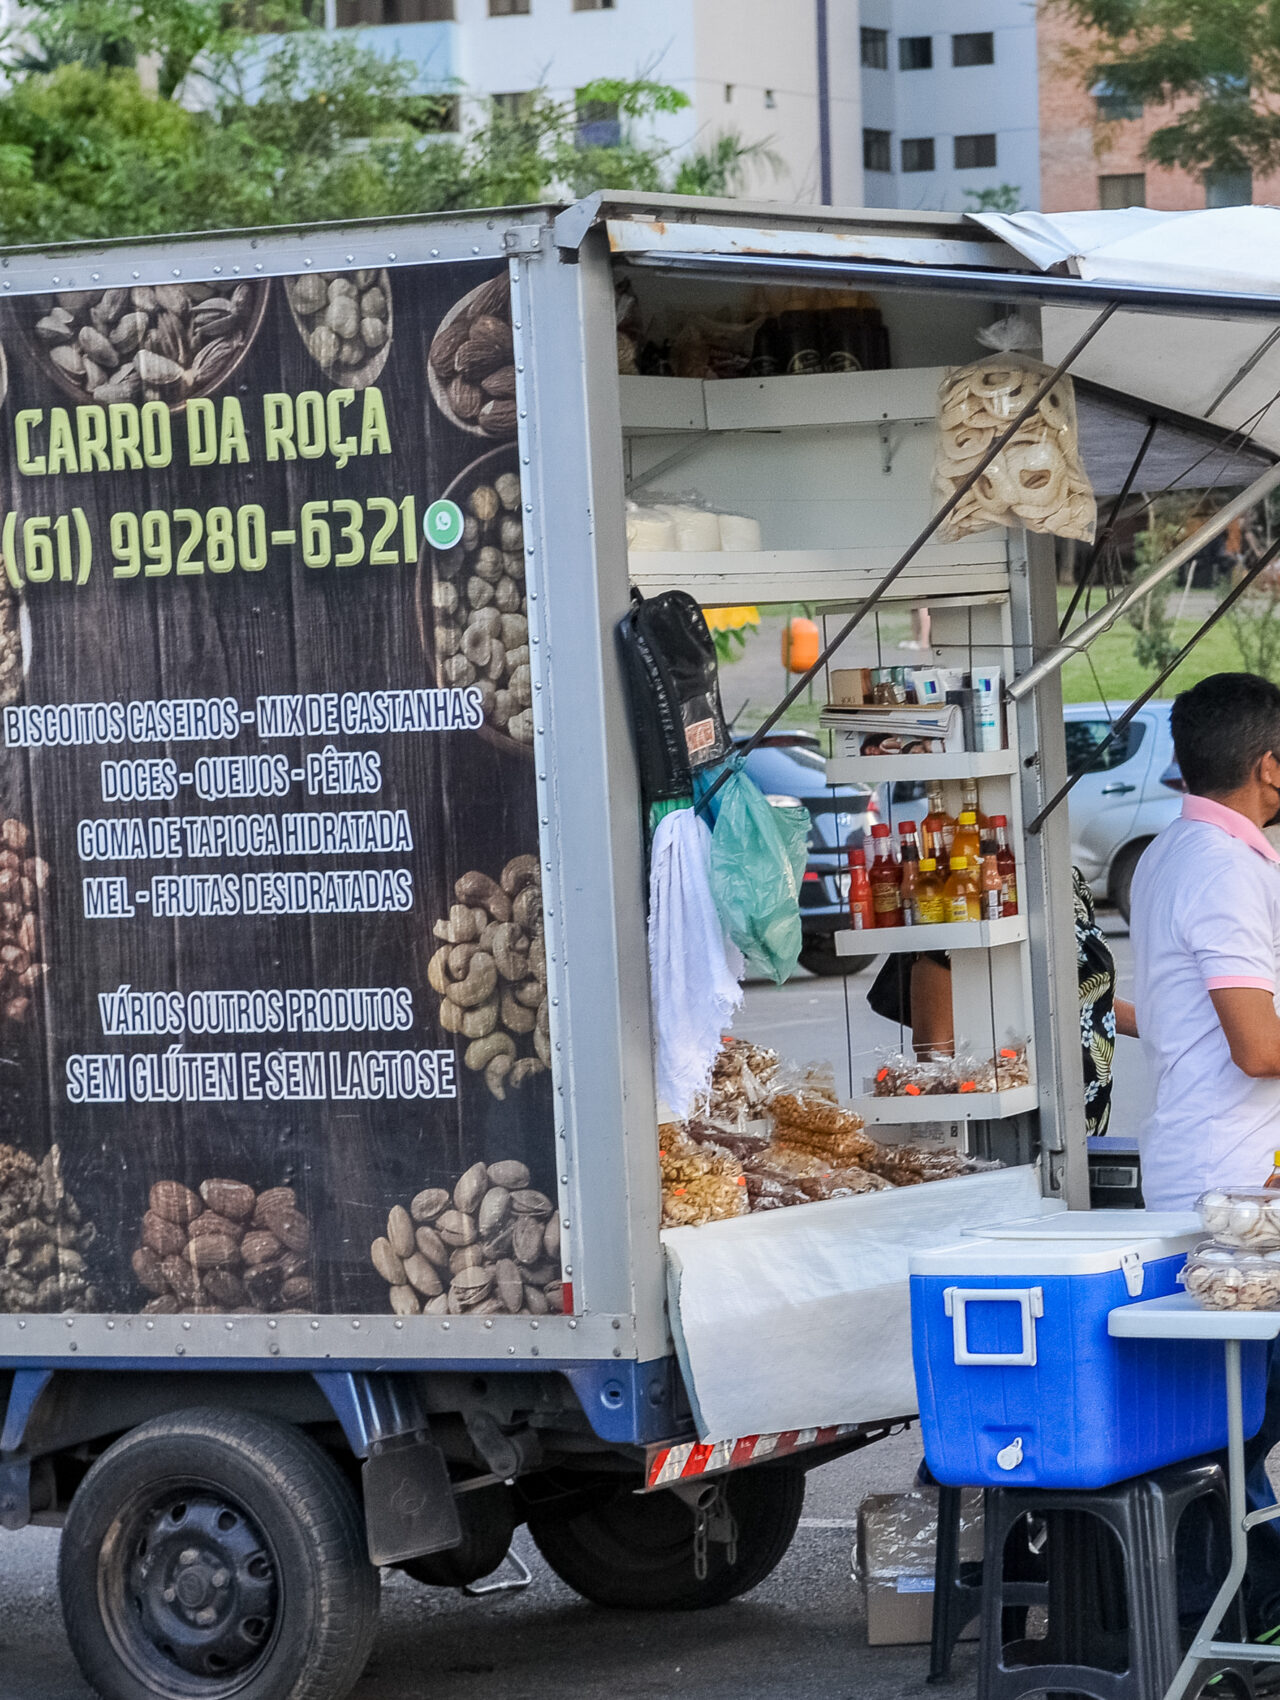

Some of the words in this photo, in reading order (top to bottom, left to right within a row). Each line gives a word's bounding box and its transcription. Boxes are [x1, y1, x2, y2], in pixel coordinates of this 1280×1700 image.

[15, 401, 173, 476] CARRO
[186, 396, 250, 466] DA
[263, 386, 392, 470] ROÇA
[3, 507, 92, 588] (61)
[110, 495, 418, 579] 99280-6321
[4, 701, 125, 747] BISCOITOS
[127, 697, 239, 743] CASEIROS
[257, 694, 305, 737] MIX
[305, 693, 340, 736] DE
[341, 687, 484, 734] CASTANHAS
[101, 758, 178, 802] DOCES
[195, 754, 290, 801] QUEIJOS
[307, 745, 382, 795] PÊTAS
[77, 818, 147, 861] GOMA
[148, 817, 182, 859] DE
[183, 814, 281, 858] TAPIOCA
[282, 810, 413, 855] HIDRATADA
[83, 876, 135, 918] MEL
[152, 873, 241, 917] FRUTAS
[242, 869, 413, 914] DESIDRATADAS
[98, 984, 186, 1035] VÁRIOS
[187, 989, 284, 1034] OUTROS
[286, 987, 414, 1033] PRODUTOS
[66, 1052, 126, 1103] SEM
[129, 1044, 239, 1102] GLÚTEN
[242, 1051, 264, 1100] E
[264, 1050, 326, 1100] SEM
[331, 1048, 457, 1100] LACTOSE
